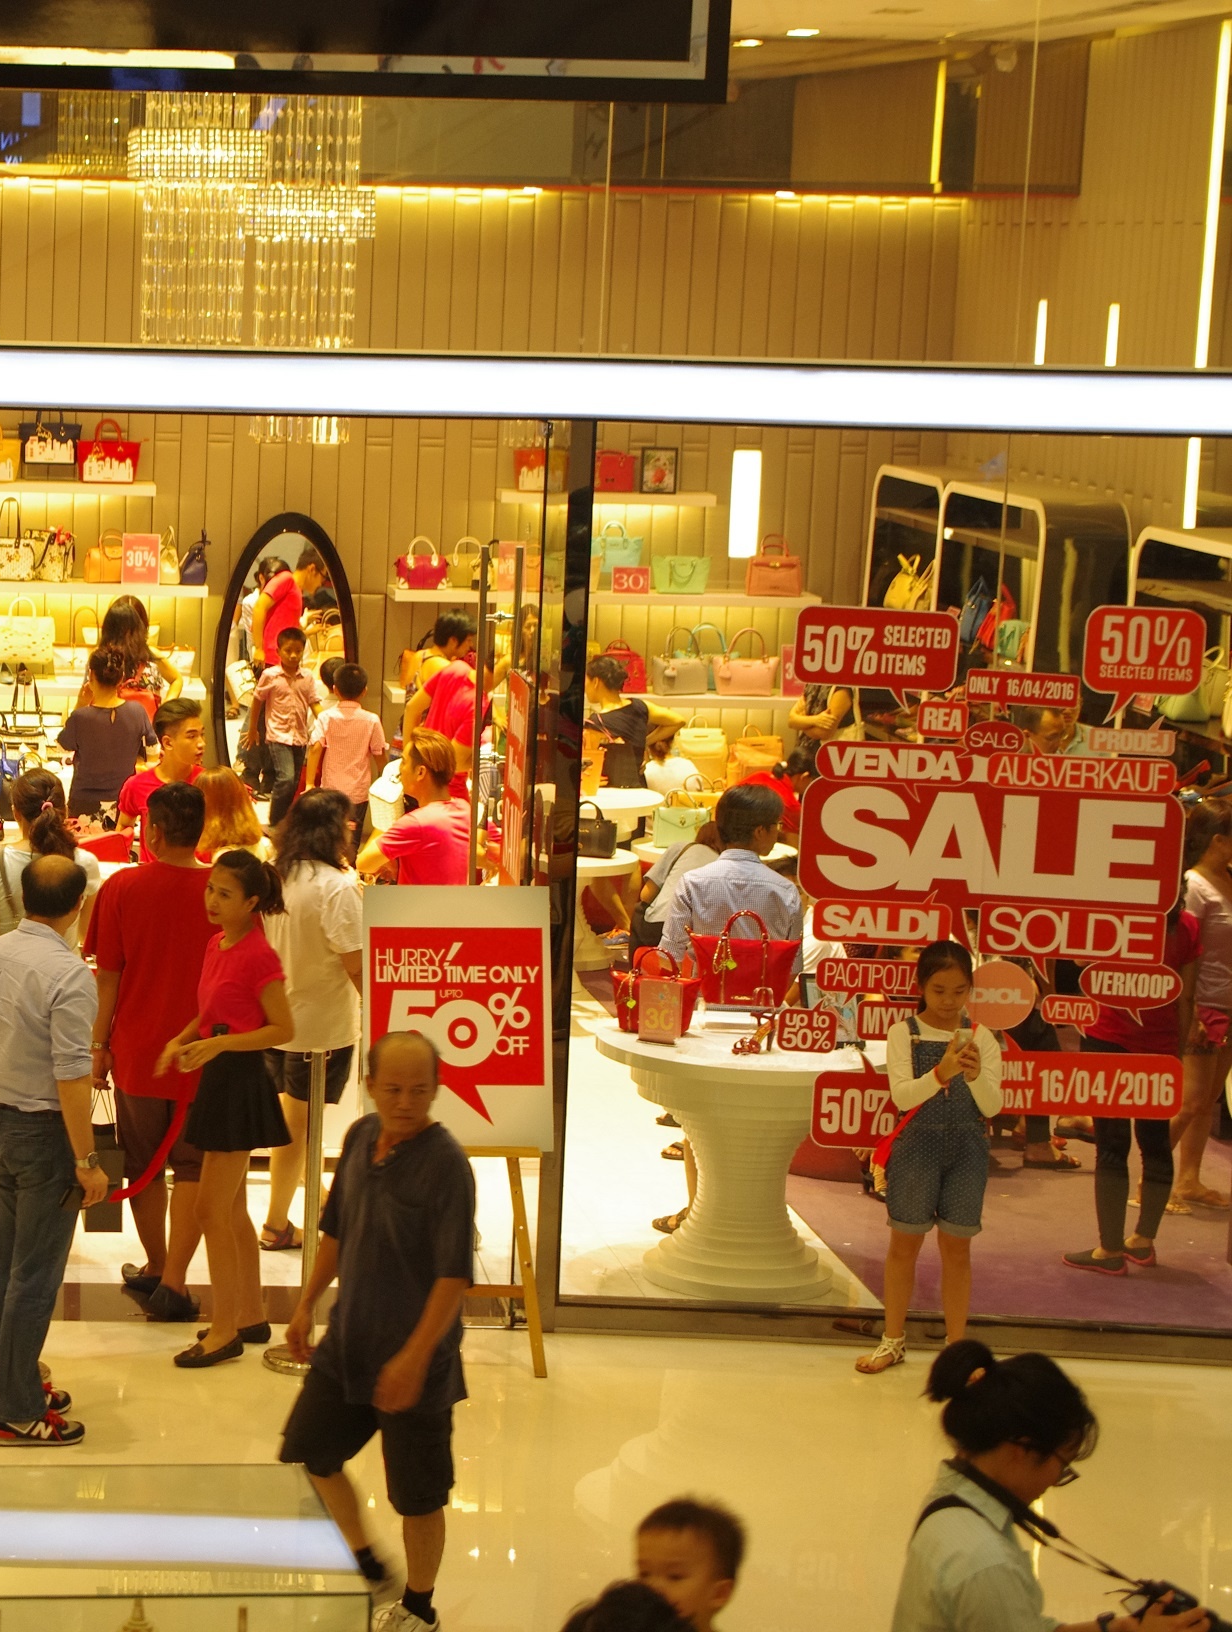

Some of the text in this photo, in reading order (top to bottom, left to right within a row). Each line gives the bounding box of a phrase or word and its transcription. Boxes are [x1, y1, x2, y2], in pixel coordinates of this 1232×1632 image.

[126, 550, 156, 567] 30%
[614, 573, 644, 590] 30
[802, 625, 878, 676] 50%
[883, 624, 952, 649] SELECTED
[1100, 615, 1191, 667] 50%
[881, 653, 926, 677] ITEMS
[1099, 665, 1193, 682] SELECTED ITEMS
[969, 676, 1075, 701] ONLY 16/04/2016
[922, 707, 963, 733] REA
[969, 730, 1020, 750] SALG
[1092, 729, 1170, 754] PRODEJ
[827, 746, 962, 781] VENDA
[992, 757, 1170, 792] AUSVERKAUF
[815, 785, 1168, 905] SALE
[821, 904, 940, 941] SALDI
[986, 906, 1156, 960] SOLDE
[375, 942, 464, 967] HURRY!
[375, 965, 540, 983] LIMITED TIME ONLY
[1090, 970, 1175, 999] VERKOOP
[785, 1012, 830, 1029] up to
[1045, 1000, 1095, 1022] VENTA
[494, 1036, 530, 1056] OFF
[781, 1030, 831, 1050] 50%
[1039, 1067, 1175, 1106] 16/04/2016
[819, 1088, 895, 1135] 50%
